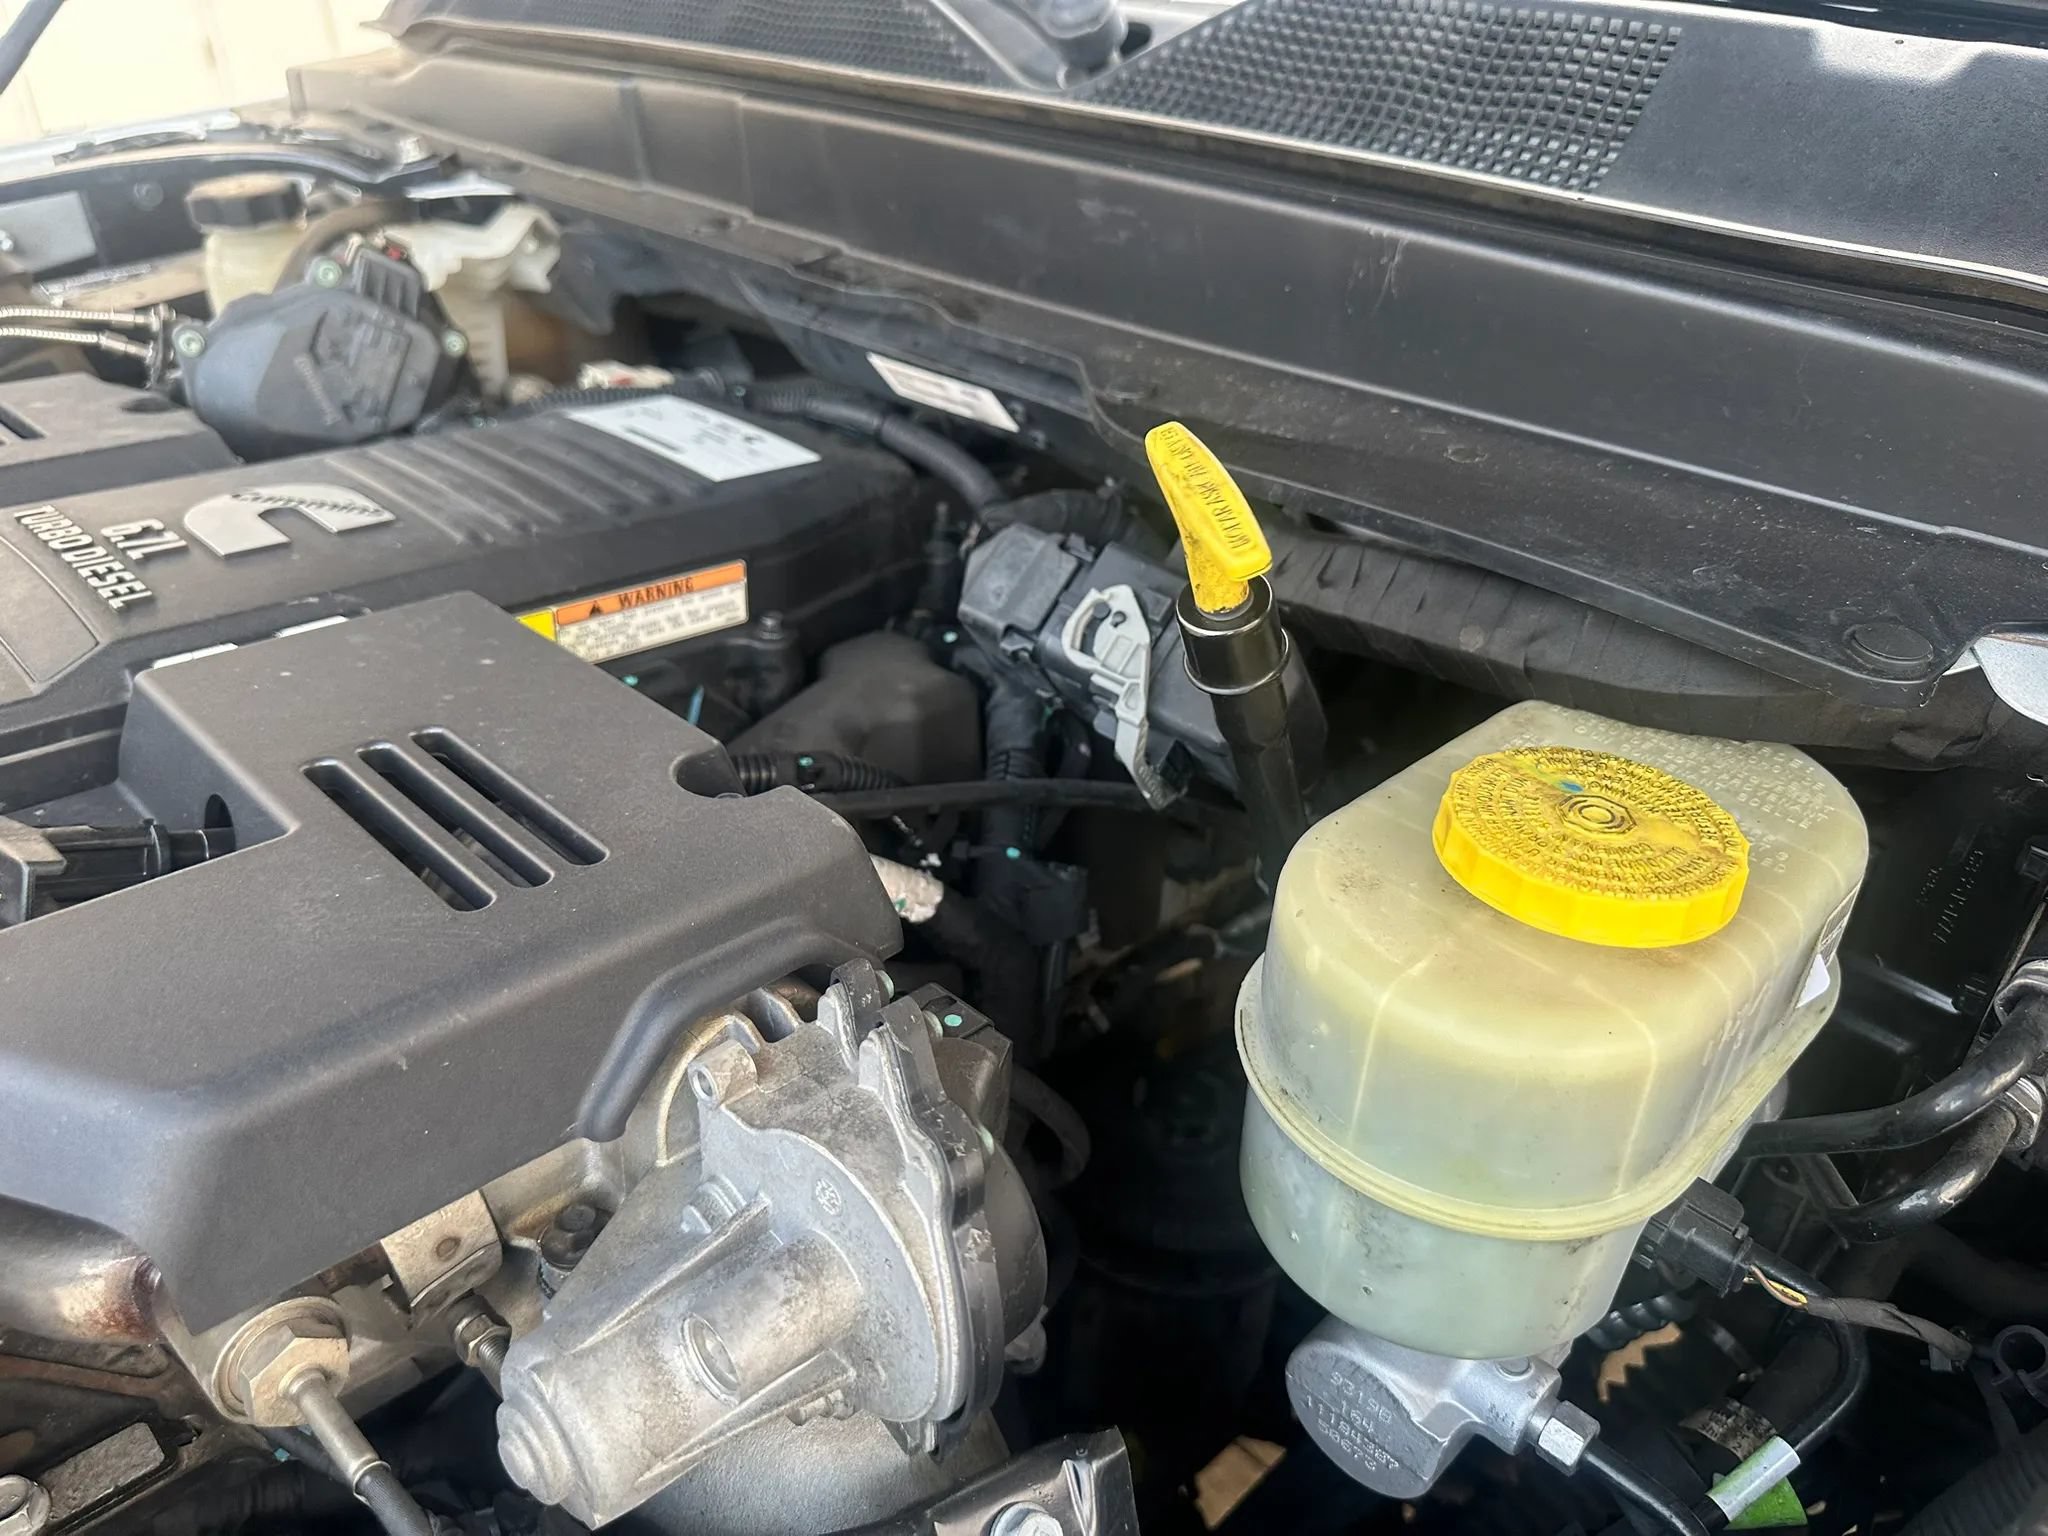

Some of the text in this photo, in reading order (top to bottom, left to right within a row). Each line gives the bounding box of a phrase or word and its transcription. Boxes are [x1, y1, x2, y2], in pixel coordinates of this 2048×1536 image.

[14, 505, 152, 609] TURBO DIESEL
[101, 518, 187, 560] 6.7L
[618, 578, 695, 609] WARNING
